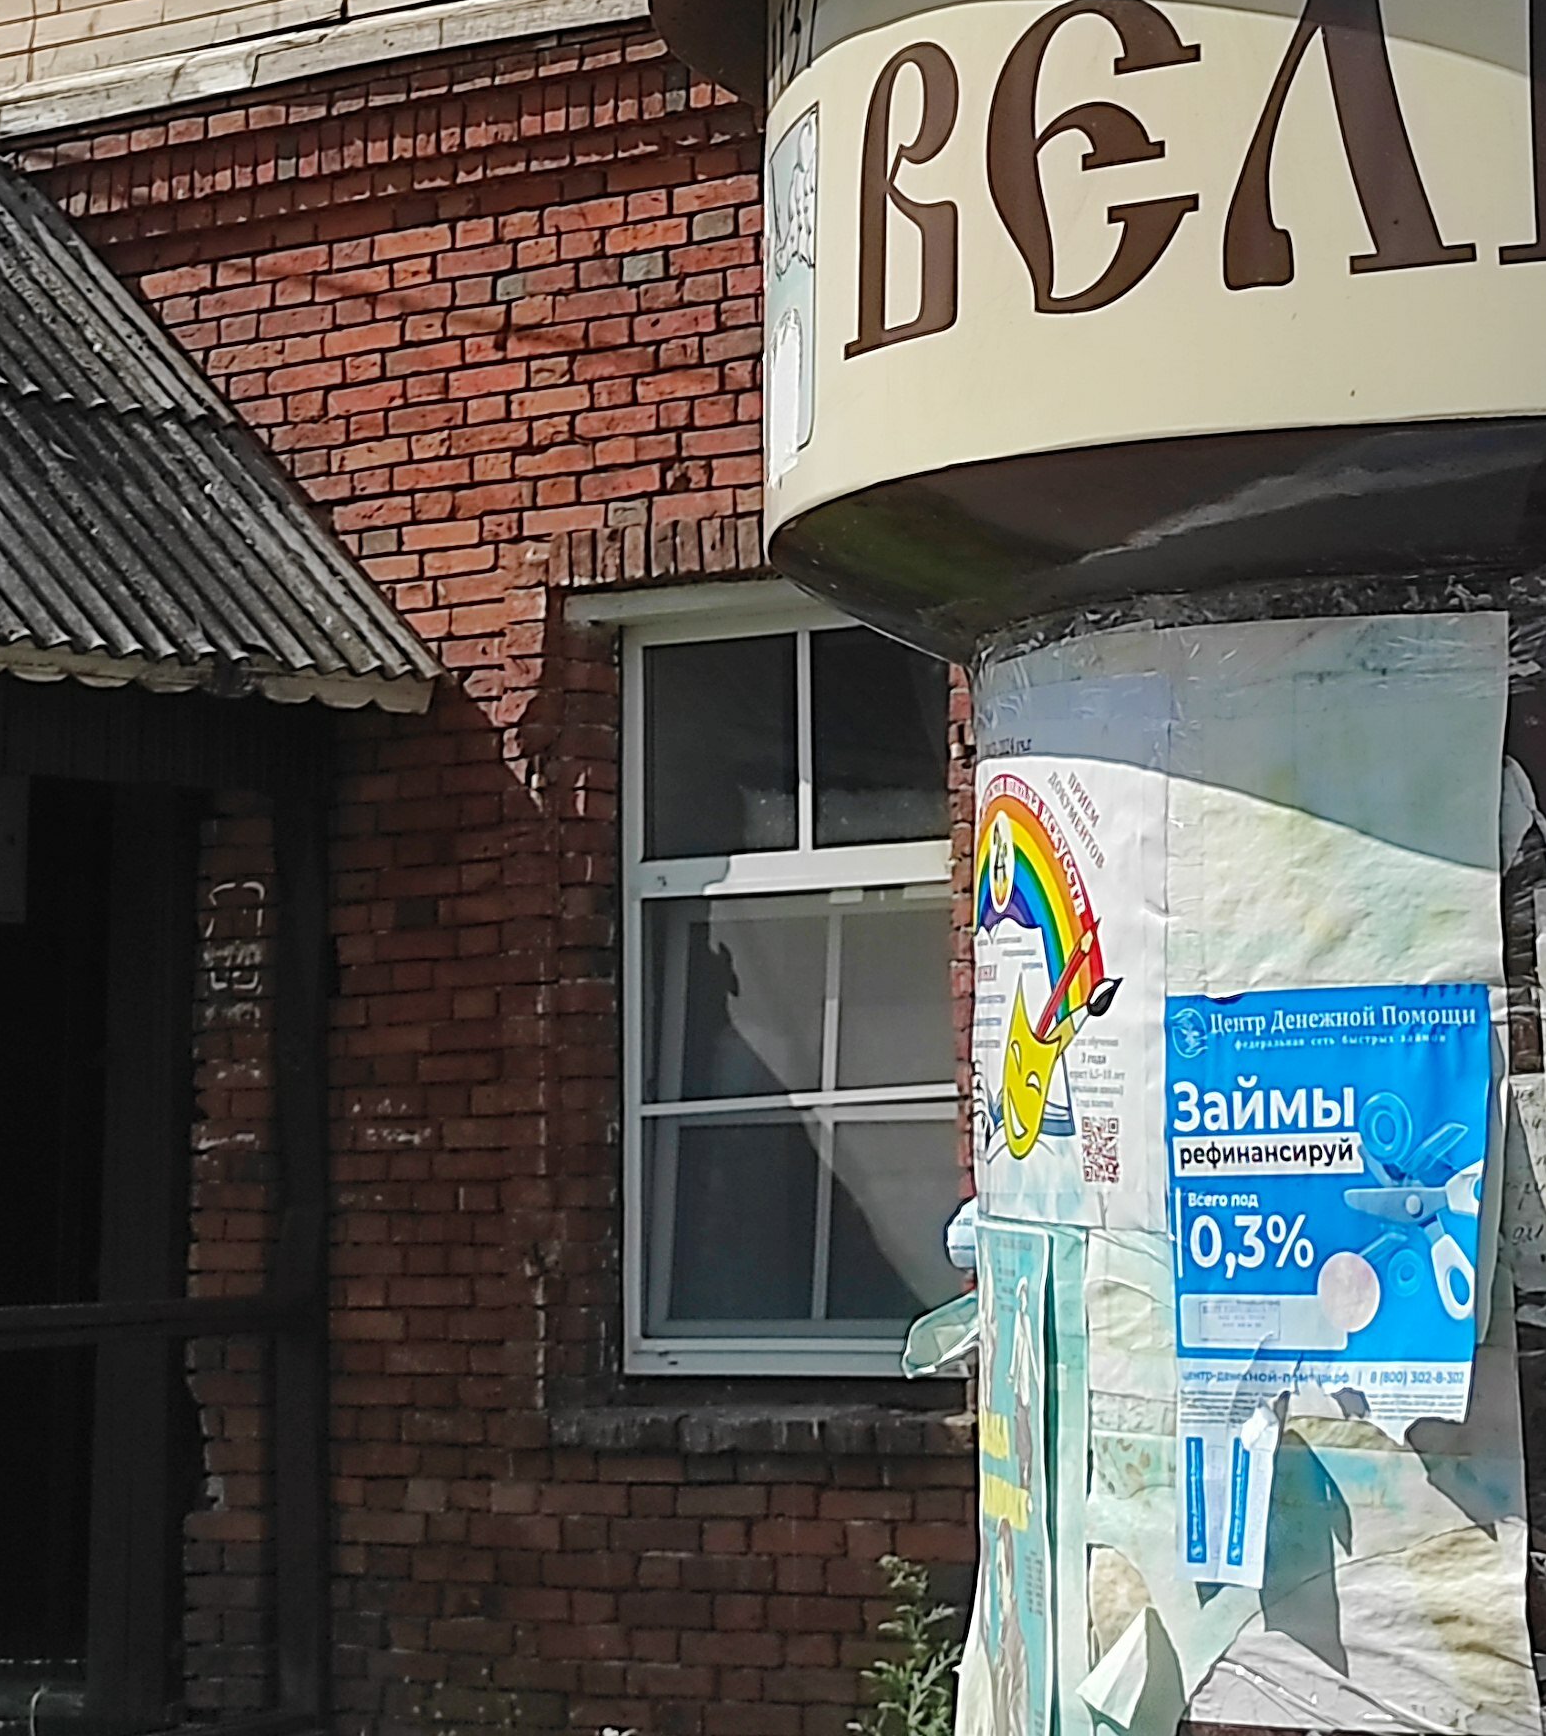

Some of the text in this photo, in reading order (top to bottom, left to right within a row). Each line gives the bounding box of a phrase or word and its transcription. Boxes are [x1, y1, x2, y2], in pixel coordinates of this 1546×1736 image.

[1047, 772, 1106, 869] ДОКУМЕНТОВ
[1067, 772, 1101, 829] ПРИЕМ
[1210, 1005, 1477, 1037] Центр Денежной Помощи
[1234, 1037, 1304, 1051] федеральная
[1310, 1037, 1335, 1047] сеть
[1341, 1033, 1394, 1046] быстрых
[1172, 1075, 1355, 1132] Займы
[1179, 1137, 1354, 1170] рефинансируй
[1188, 1192, 1259, 1208] Всего под
[1189, 1214, 1314, 1279] 0,3%
